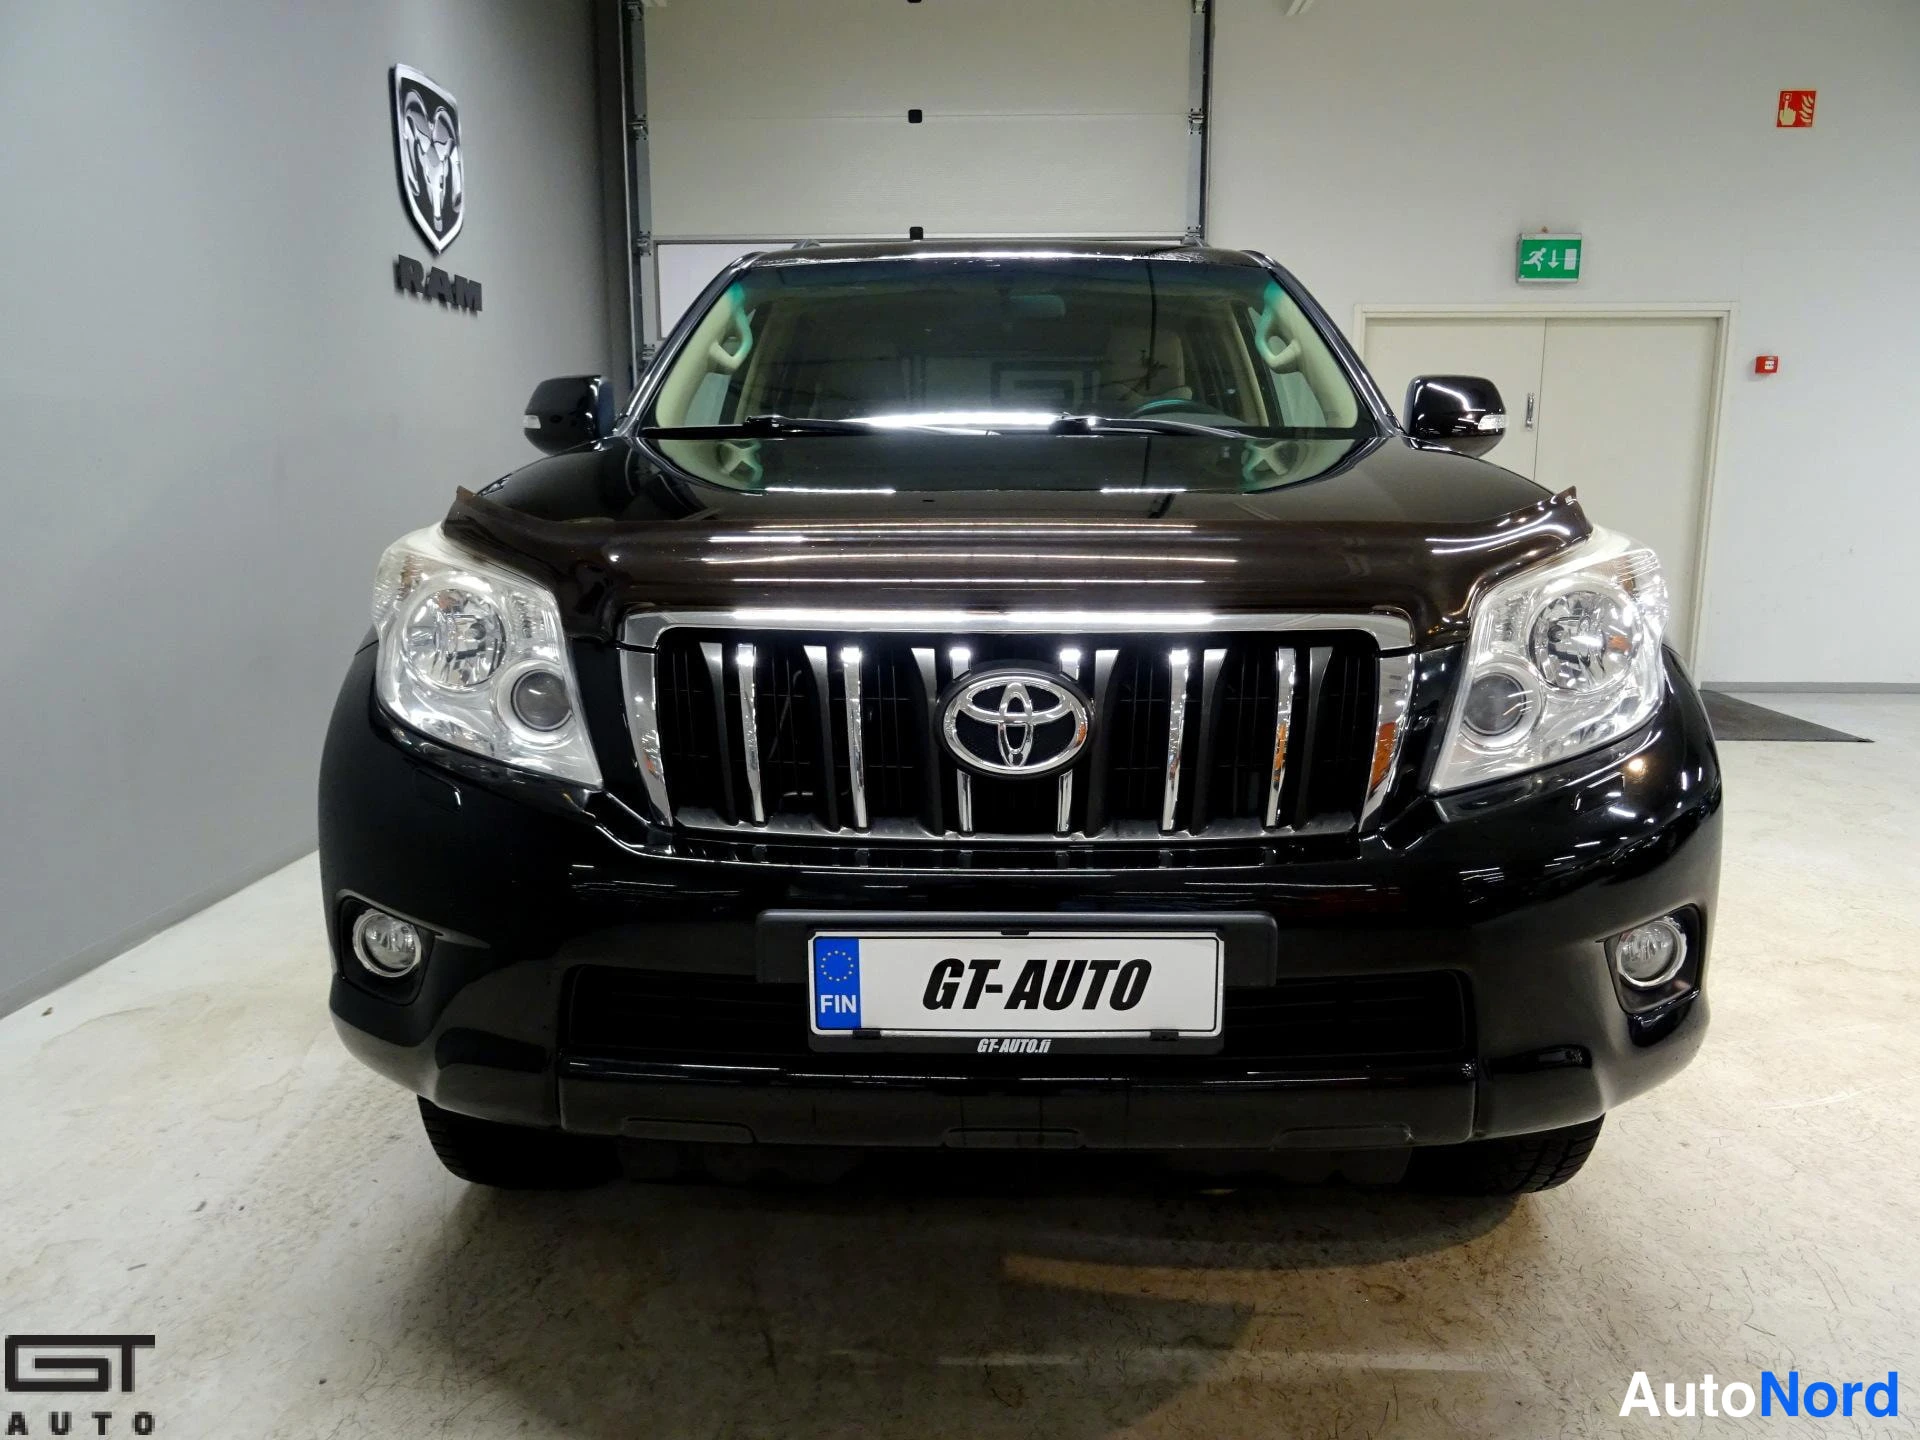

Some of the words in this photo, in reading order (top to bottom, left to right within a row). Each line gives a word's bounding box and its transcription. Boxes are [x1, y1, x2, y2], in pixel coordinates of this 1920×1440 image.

[398, 254, 483, 312] RAM
[922, 957, 1153, 1011] GT-AUTO
[819, 994, 858, 1014] FIN
[976, 1038, 1050, 1054] GT-AUTO.fi
